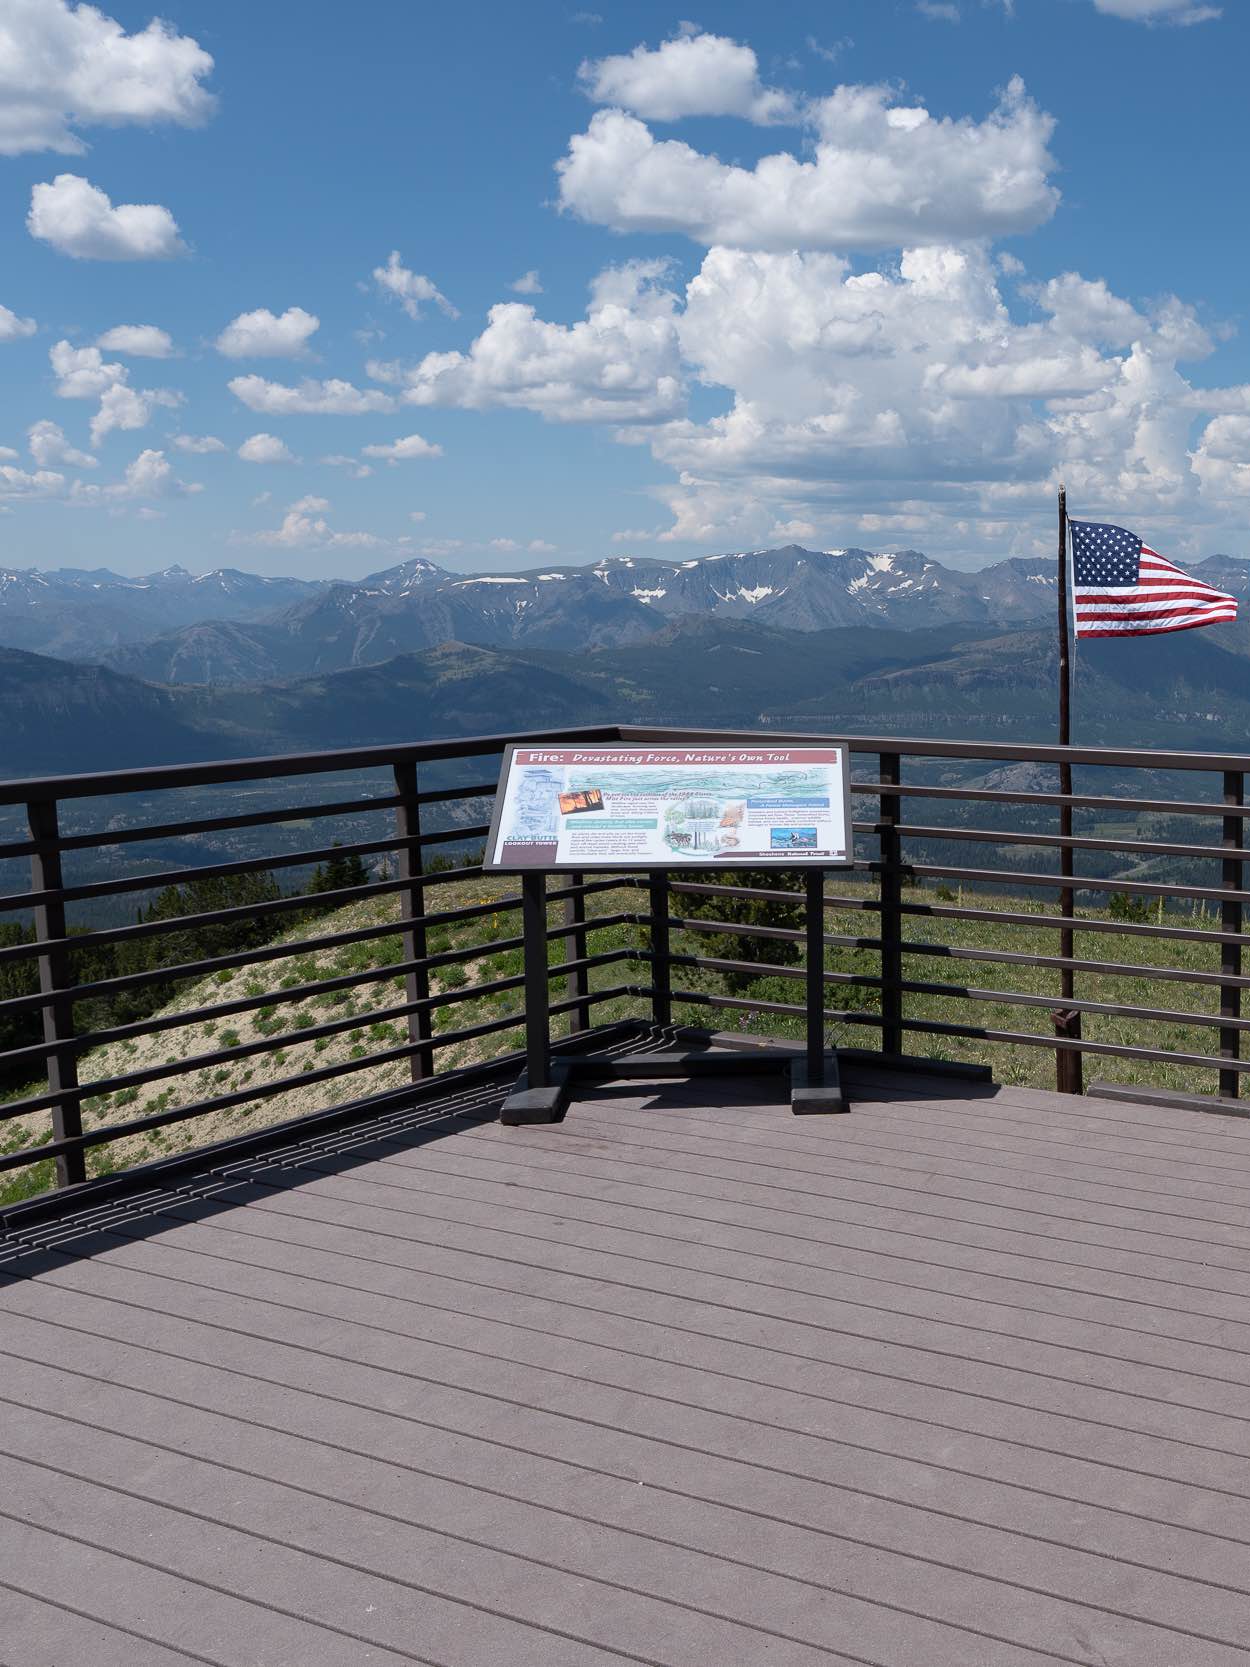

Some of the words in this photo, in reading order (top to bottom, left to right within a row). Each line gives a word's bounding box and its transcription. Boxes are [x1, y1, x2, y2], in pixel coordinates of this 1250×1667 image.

[529, 753, 564, 762] Fire:
[572, 753, 643, 764] Devastating
[646, 754, 680, 763] Force,
[684, 753, 736, 762] Nature's
[767, 753, 790, 761] Tool
